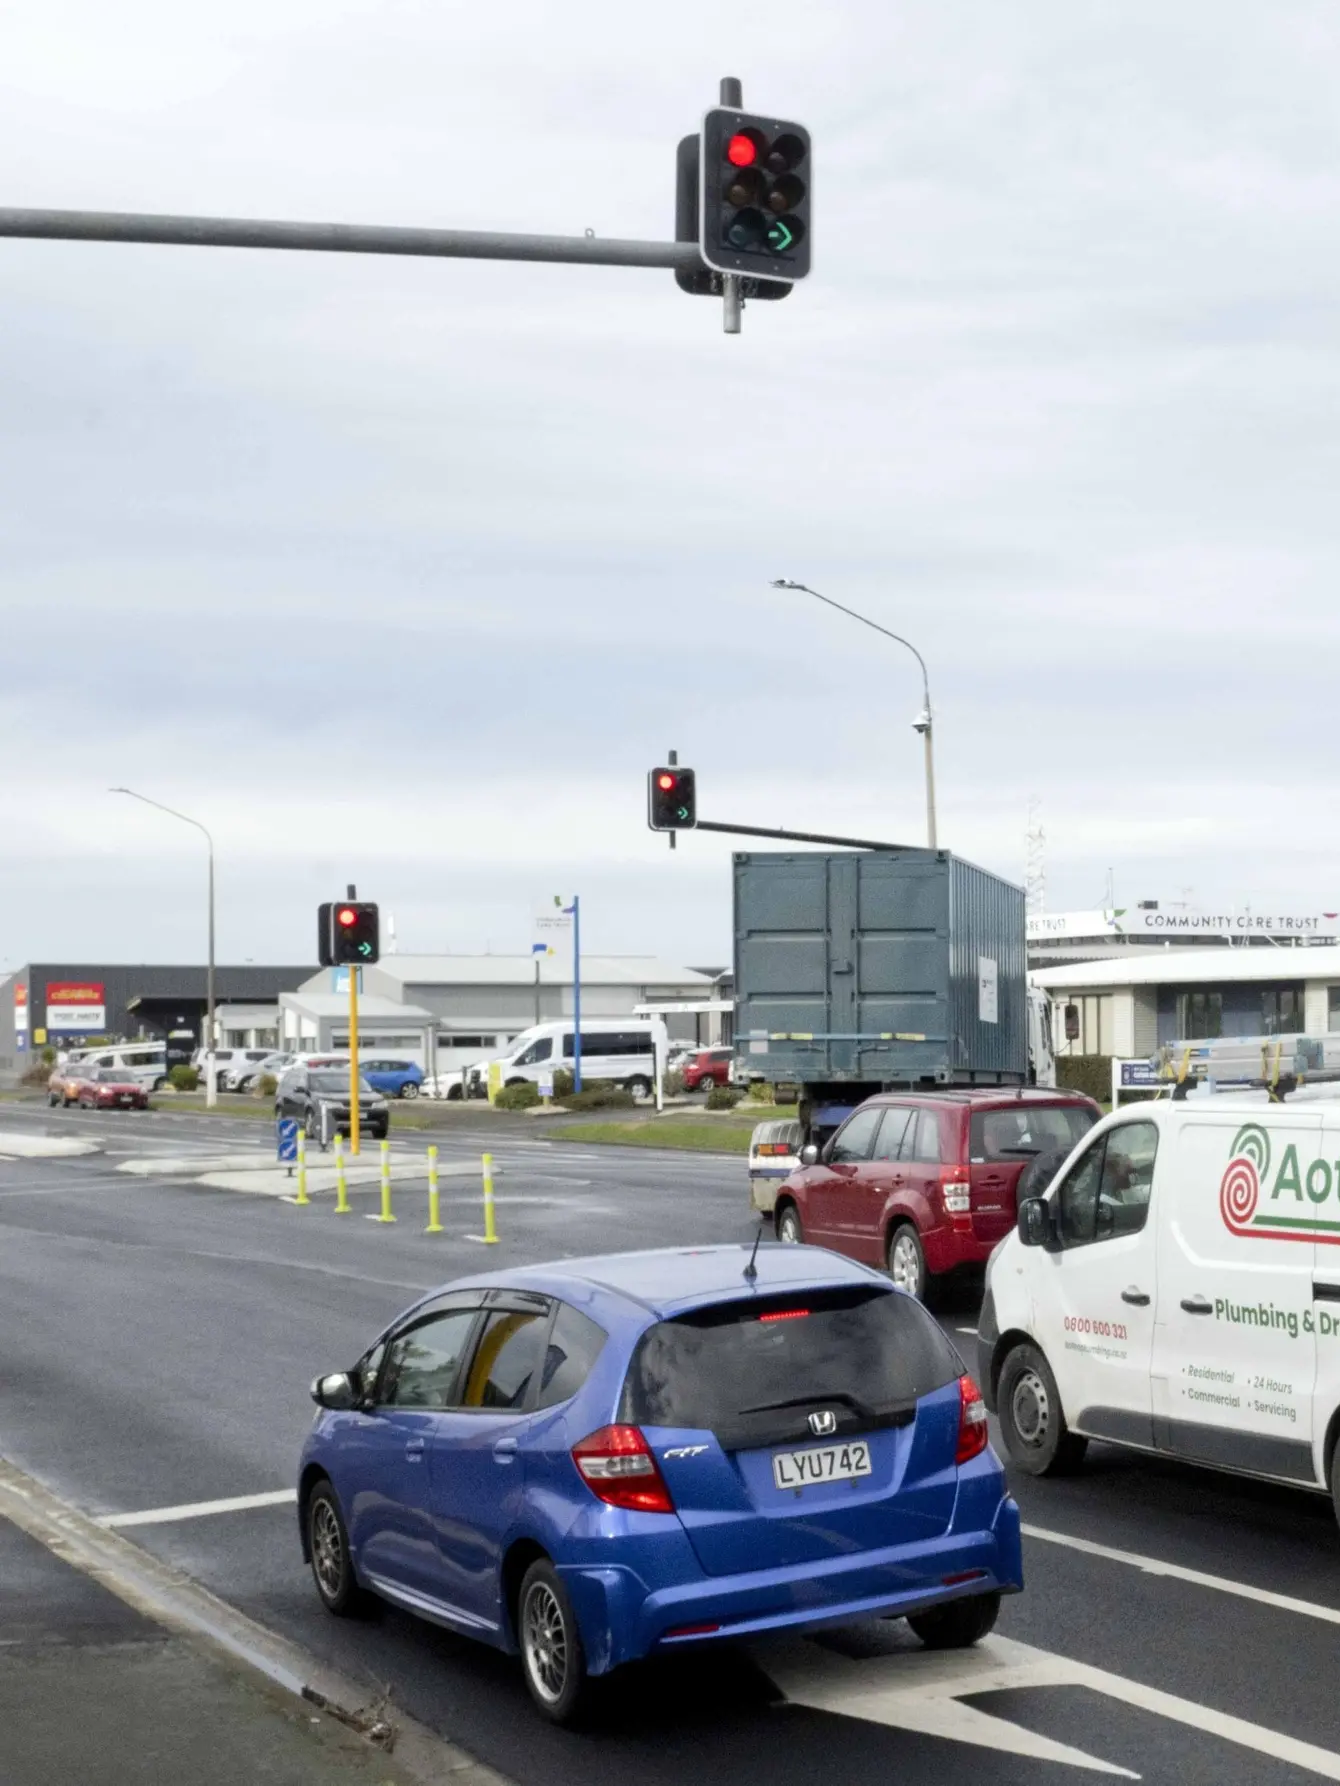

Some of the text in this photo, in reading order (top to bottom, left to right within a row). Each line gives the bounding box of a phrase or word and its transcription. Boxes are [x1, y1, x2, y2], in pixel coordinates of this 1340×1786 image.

[1145, 914, 1319, 931] COMMUNITY CARE TRUST
[1064, 1316, 1128, 1340] 0800 600 321
[1215, 1299, 1298, 1339] Plumbing
[1302, 1310, 1315, 1333] &
[1188, 1364, 1293, 1395] Residential 24 Hours
[1188, 1388, 1297, 1422] Commercial Servicing
[778, 1447, 867, 1483] LYU742
